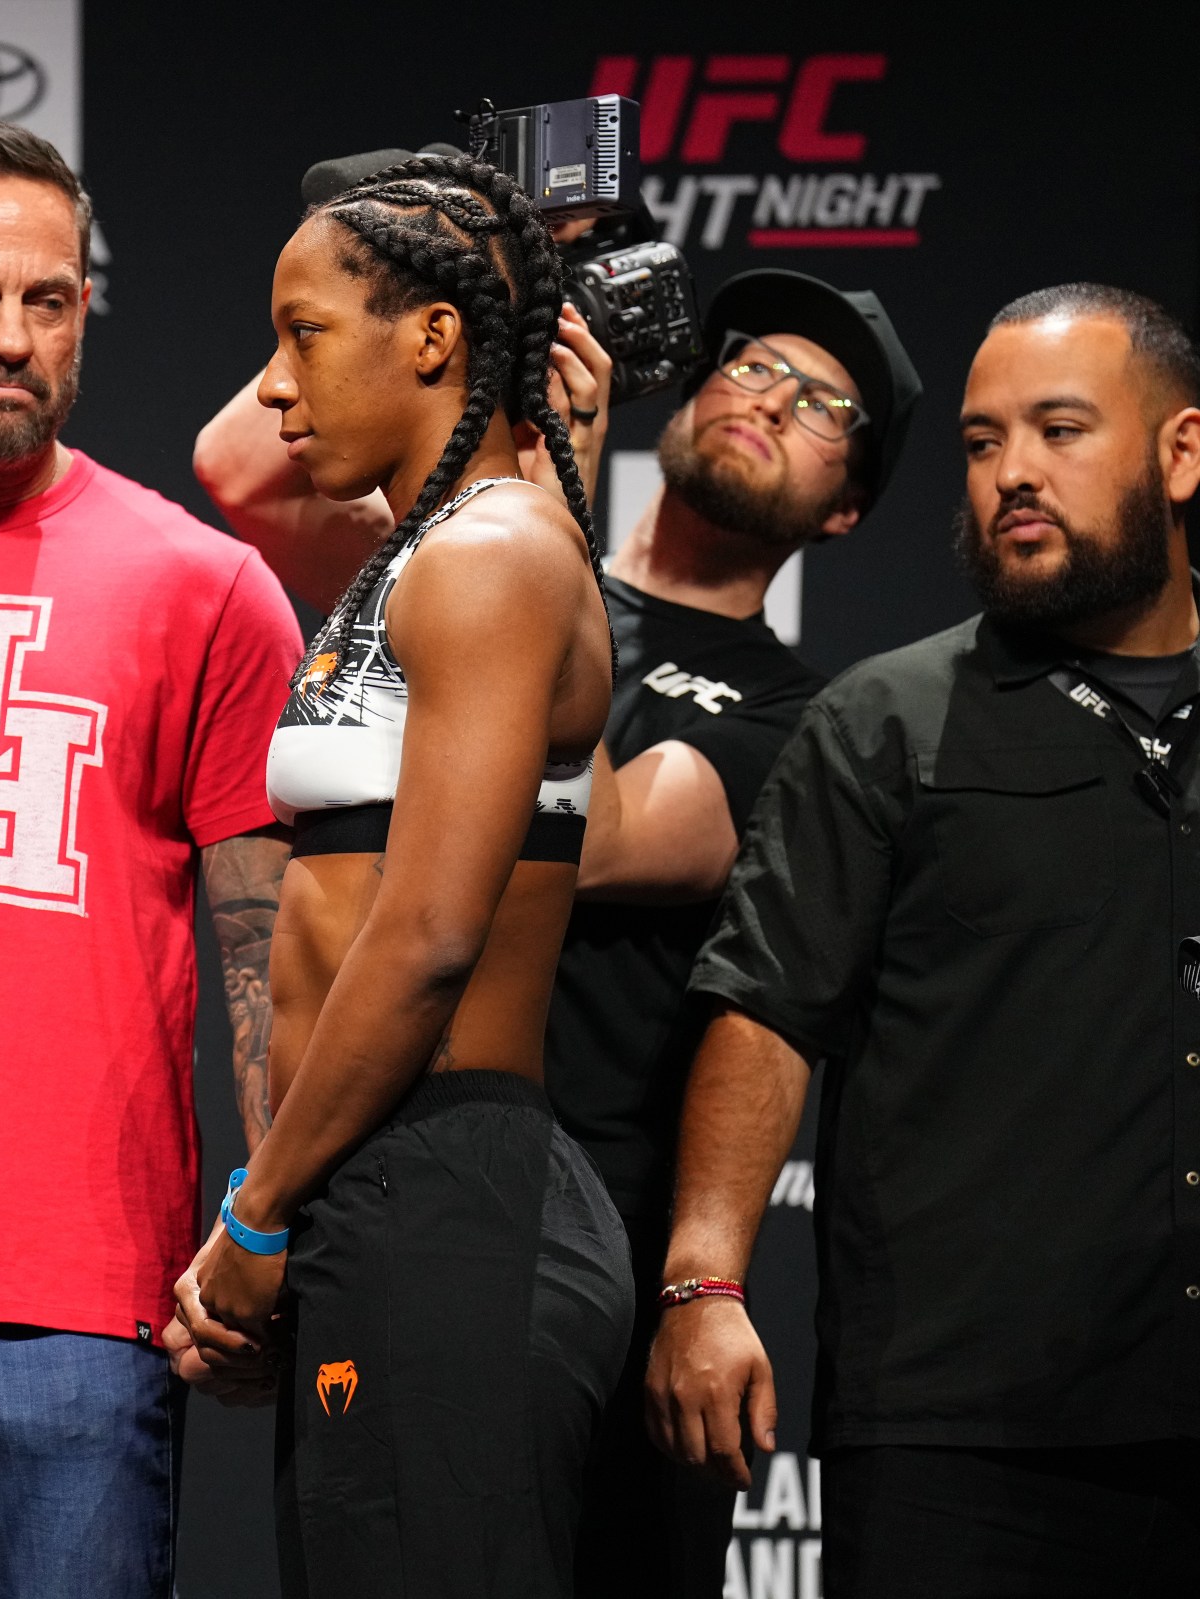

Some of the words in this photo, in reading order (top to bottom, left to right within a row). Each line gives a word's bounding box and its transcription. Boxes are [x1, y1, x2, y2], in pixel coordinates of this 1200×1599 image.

[588, 55, 886, 164] UFC
[751, 172, 940, 228] NIGHT
[641, 662, 742, 715] UFC
[1069, 682, 1111, 718] UFC
